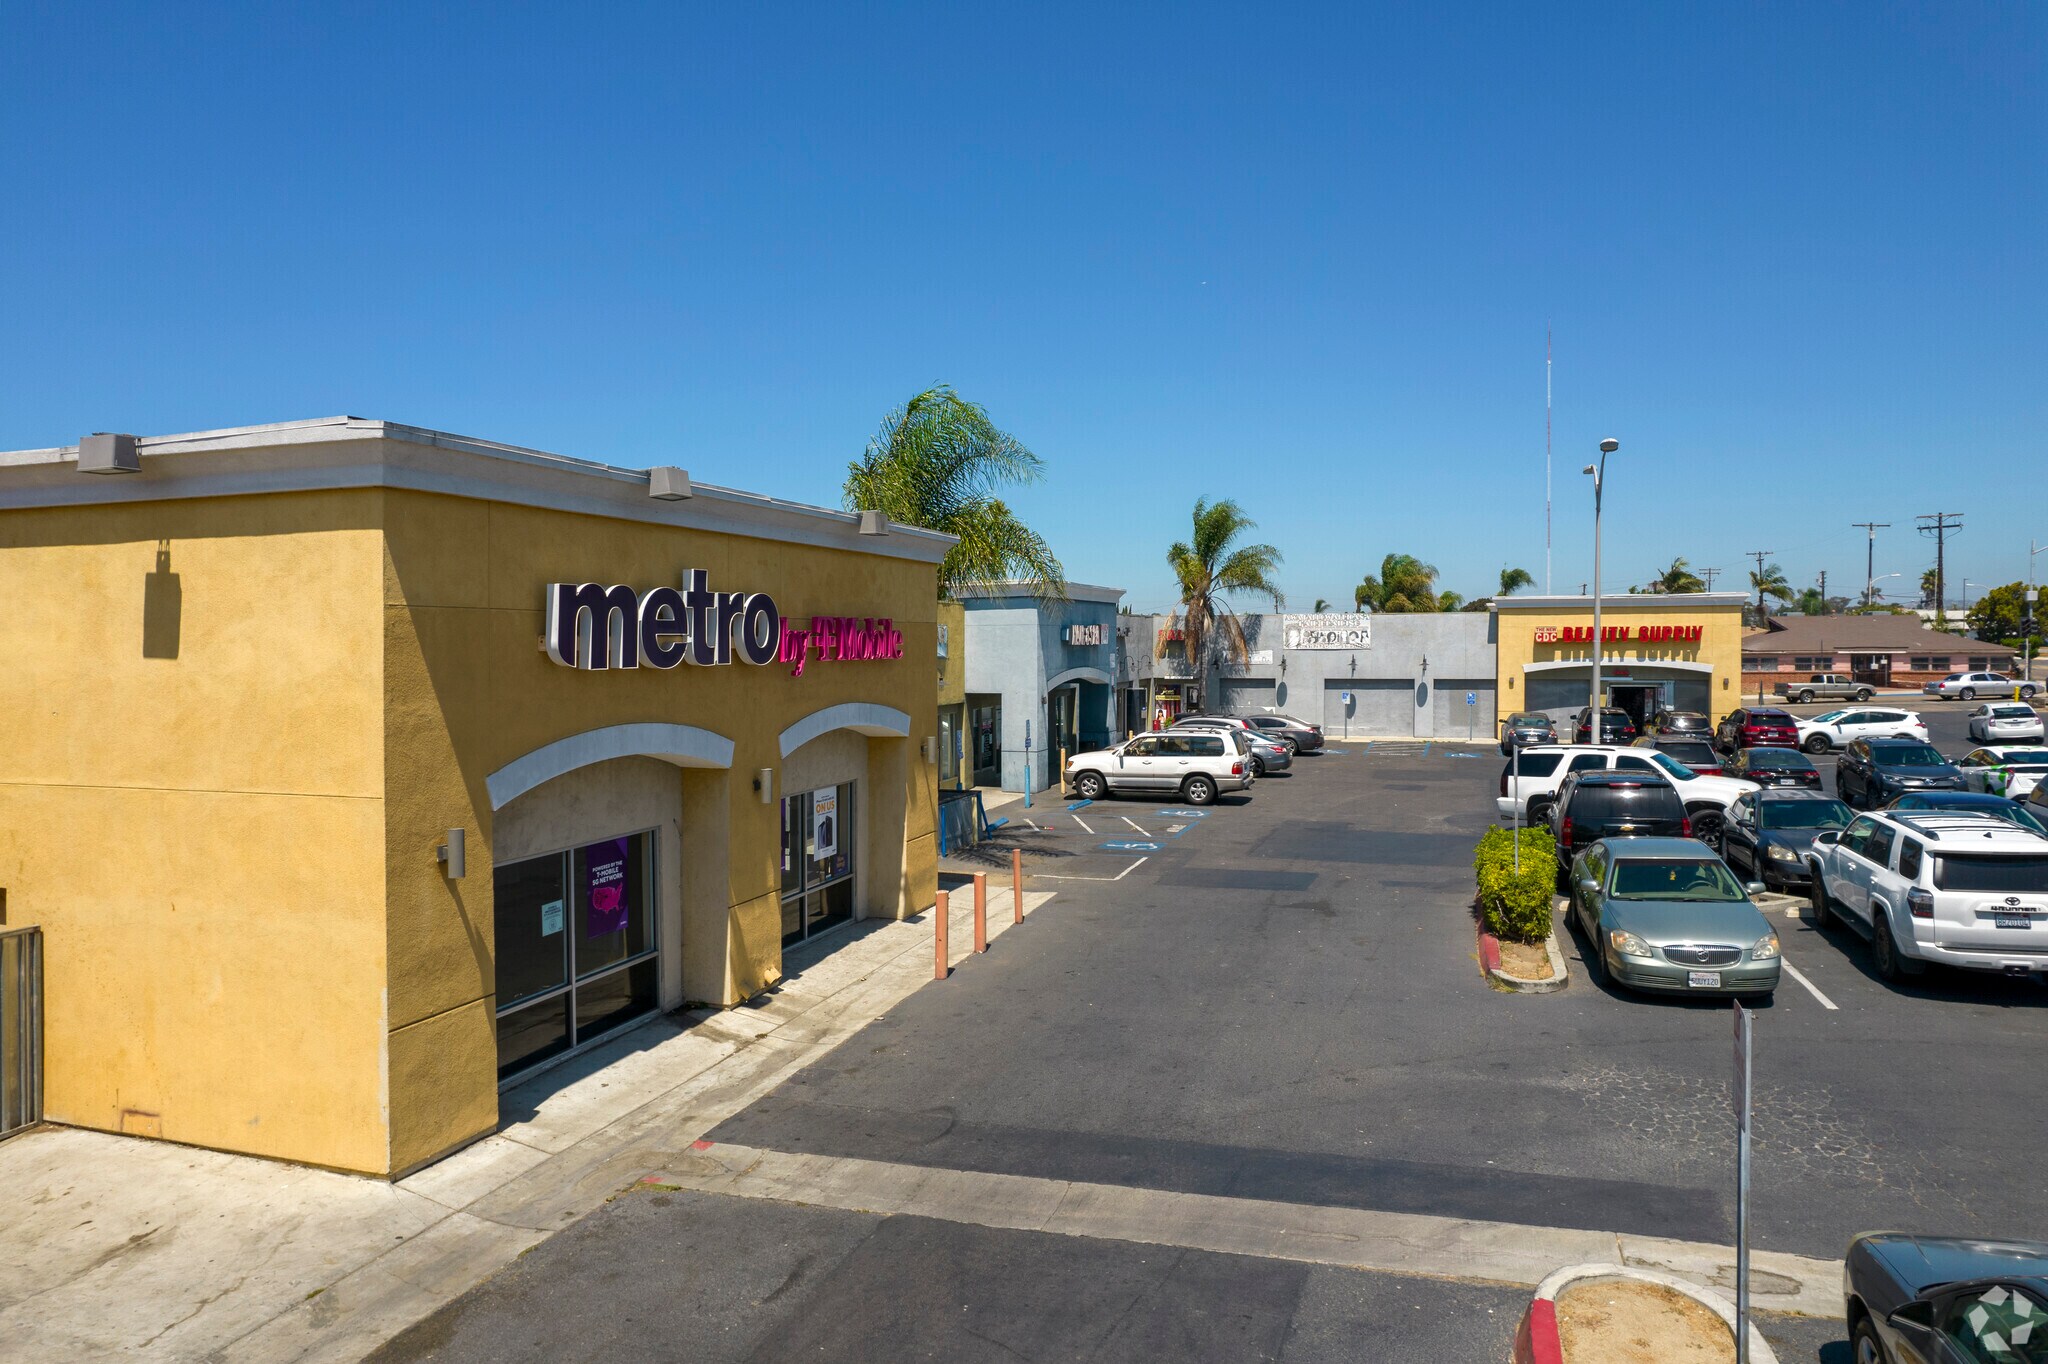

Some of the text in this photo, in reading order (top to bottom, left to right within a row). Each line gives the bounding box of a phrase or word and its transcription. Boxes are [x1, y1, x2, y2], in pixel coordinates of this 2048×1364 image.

[547, 568, 780, 670] metro
[778, 616, 811, 678] by
[1535, 632, 1557, 642] CDC
[1563, 626, 1703, 642] BEAUTY SUPPLY
[816, 800, 835, 813] ON US
[592, 864, 610, 872] POWERED
[596, 867, 618, 877] T-MOBILE
[600, 872, 623, 883] NETWORK
